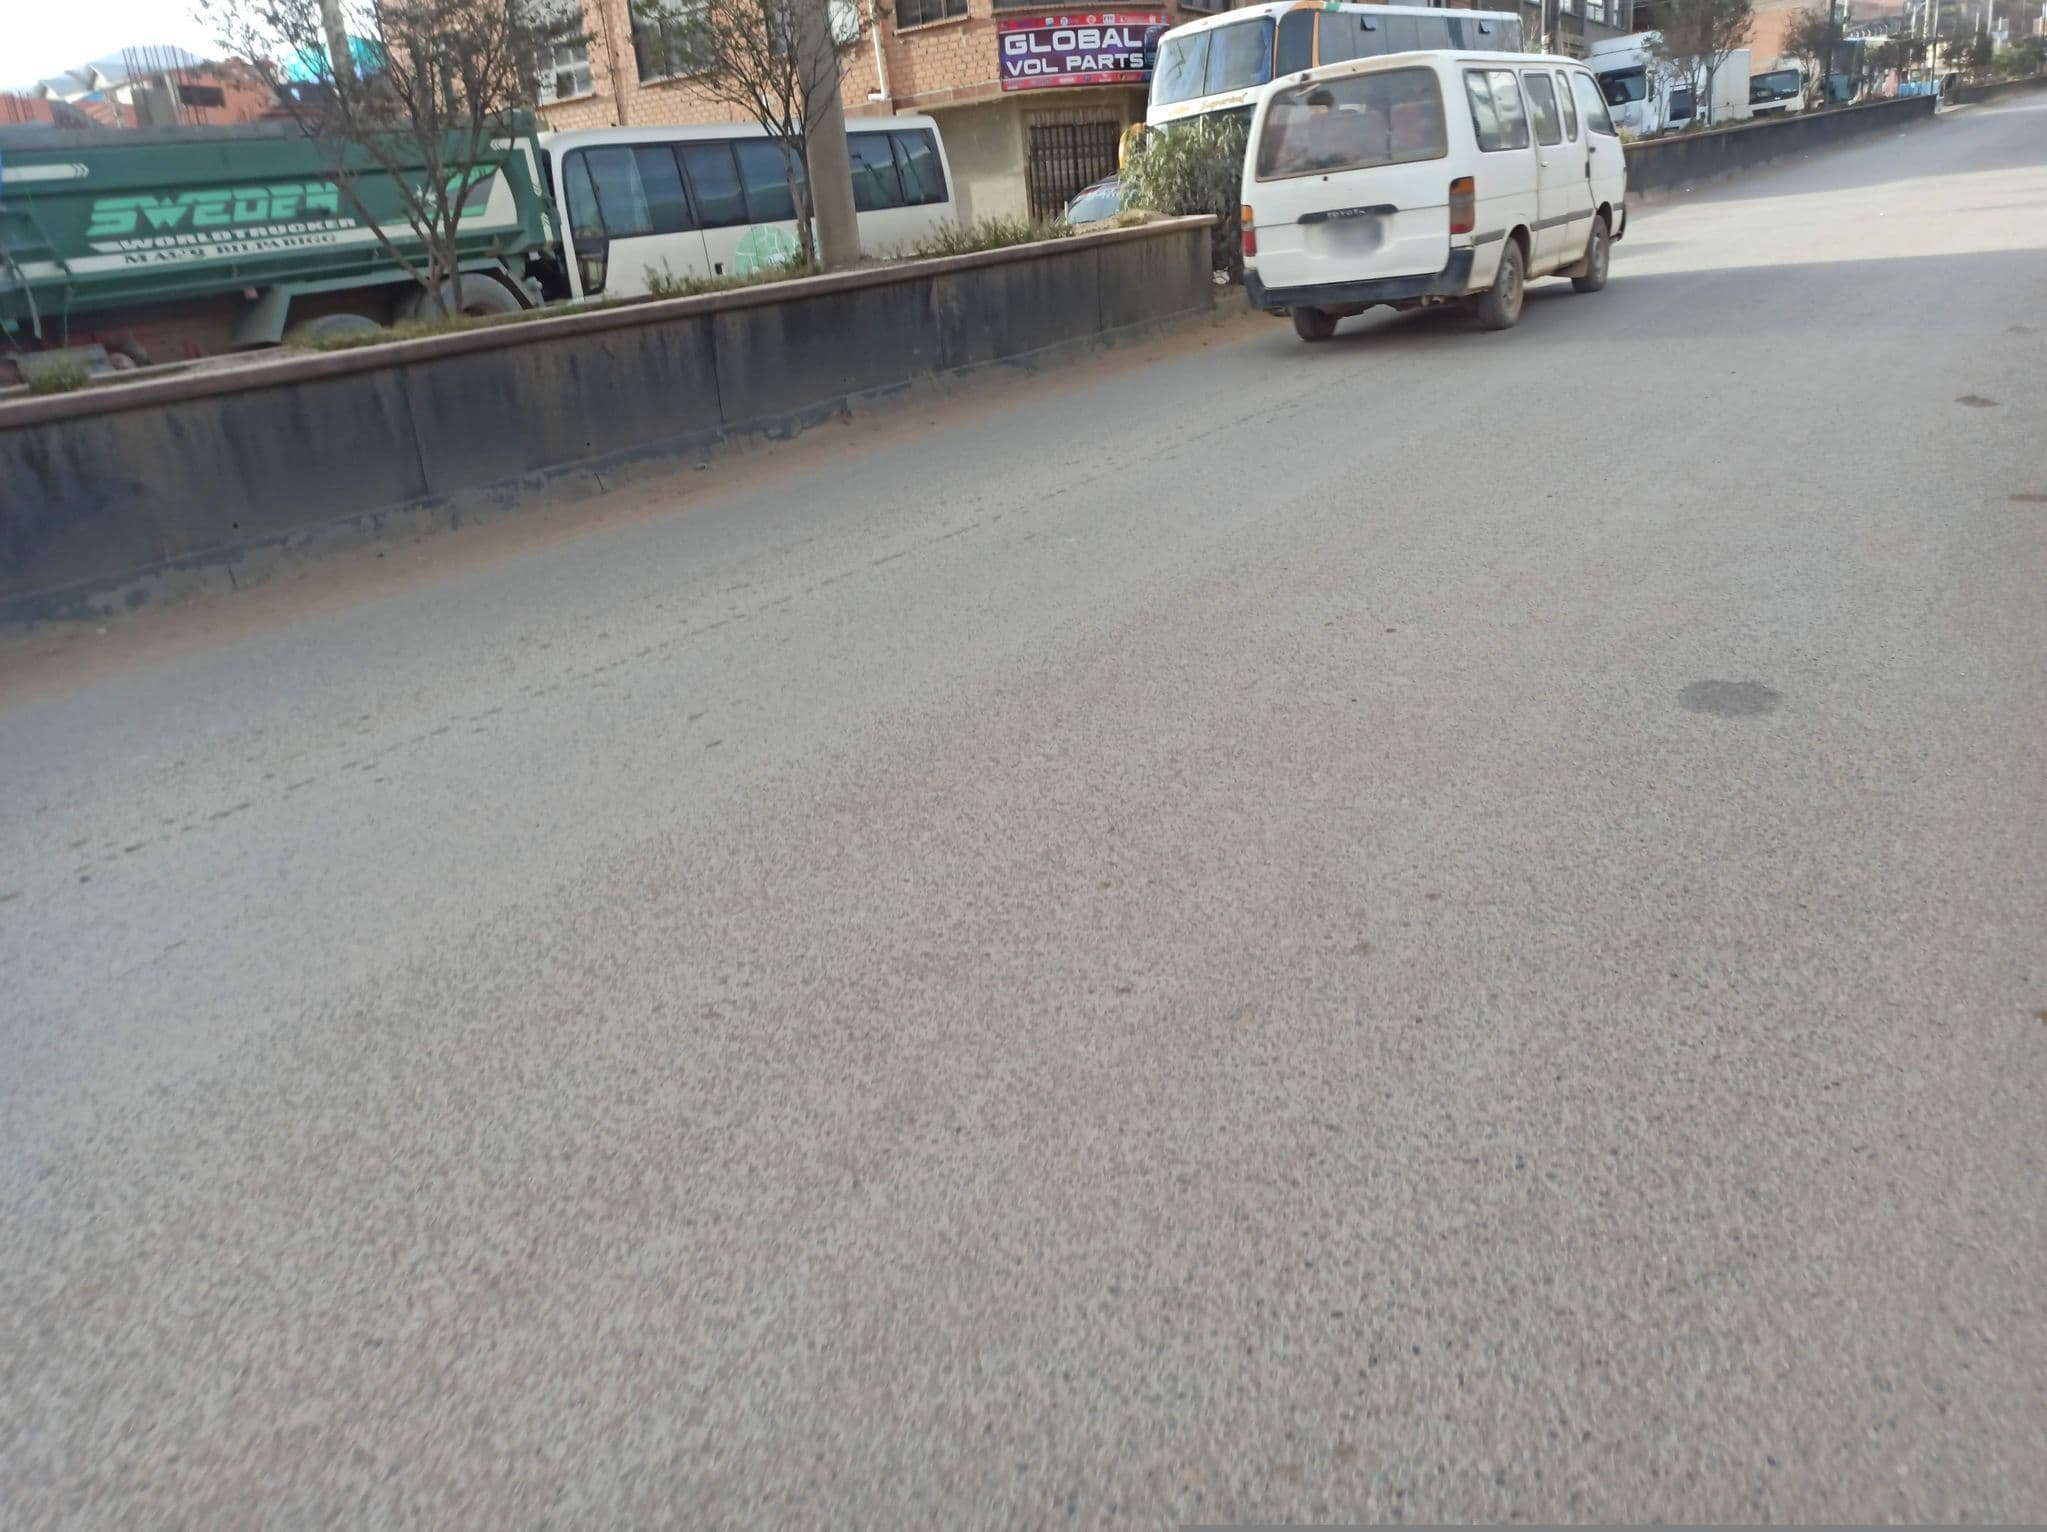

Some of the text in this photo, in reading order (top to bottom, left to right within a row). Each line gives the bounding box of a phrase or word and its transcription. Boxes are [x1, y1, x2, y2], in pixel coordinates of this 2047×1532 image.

[1004, 28, 1143, 56] GLOBAL
[1006, 53, 1144, 76] VOL PARTS
[86, 182, 339, 236] SWEDEN
